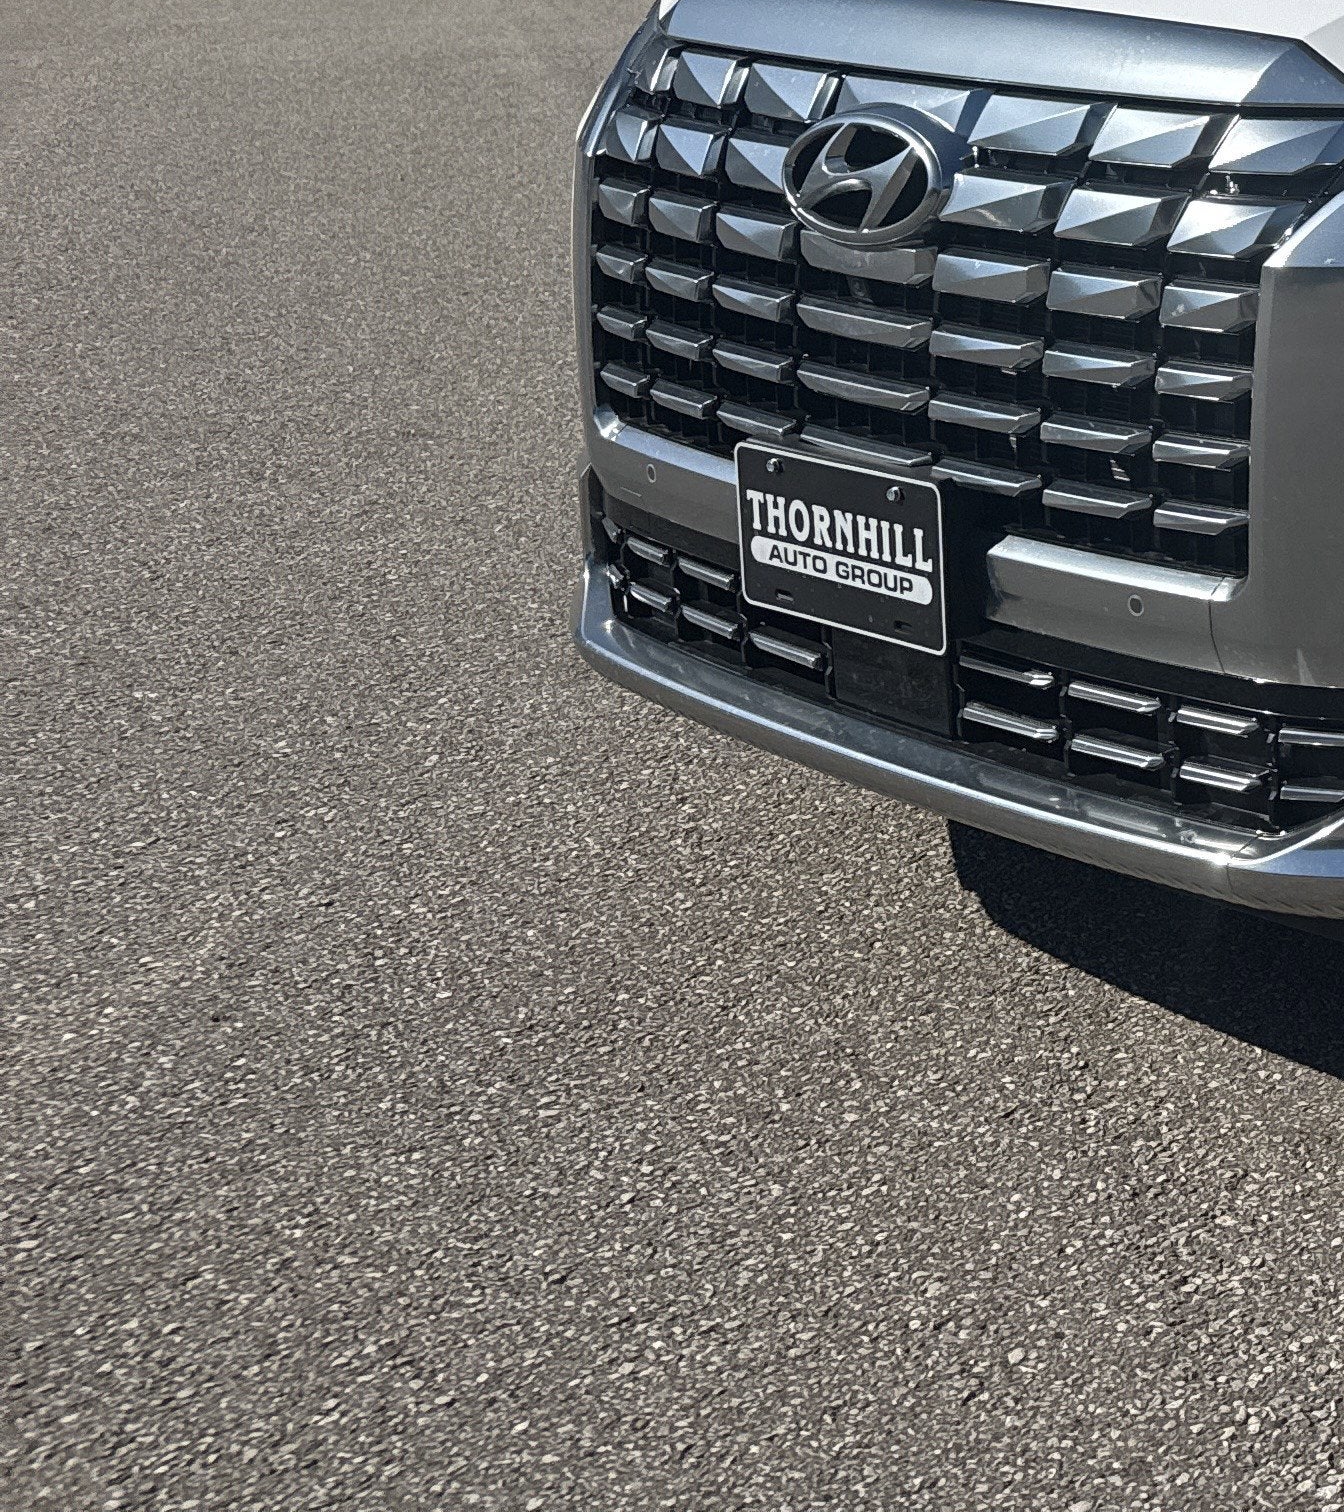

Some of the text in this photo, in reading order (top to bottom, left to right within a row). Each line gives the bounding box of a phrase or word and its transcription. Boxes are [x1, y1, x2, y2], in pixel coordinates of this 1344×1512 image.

[746, 489, 933, 573] THORNHILL
[768, 544, 914, 596] AUTO GROUP
